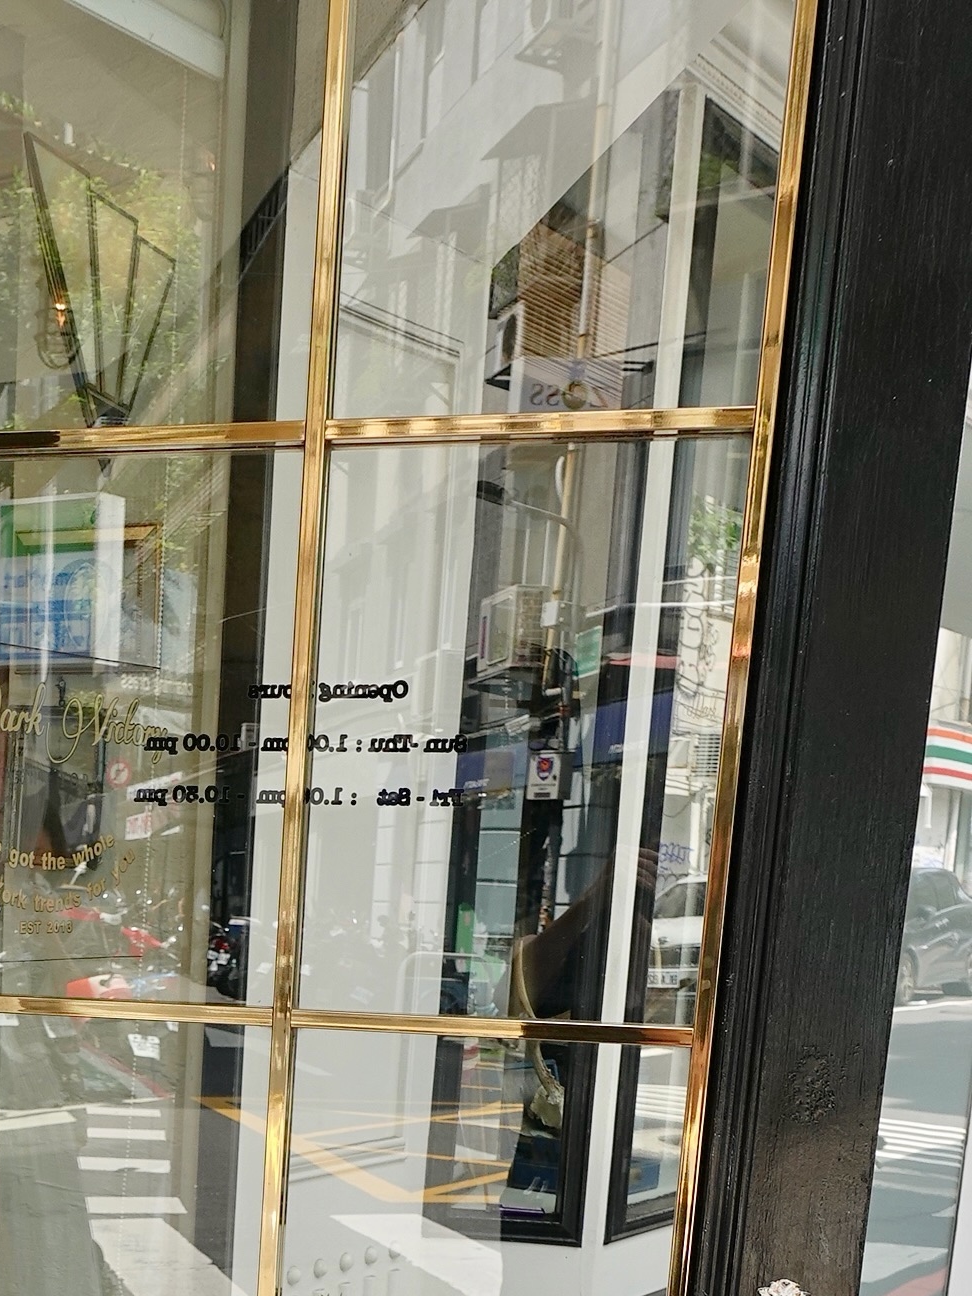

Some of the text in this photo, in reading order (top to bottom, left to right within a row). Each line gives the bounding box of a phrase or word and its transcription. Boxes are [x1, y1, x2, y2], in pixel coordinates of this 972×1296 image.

[9, 846, 36, 868] got
[42, 851, 66, 871] the
[72, 833, 115, 865] whole
[34, 892, 81, 913] trends
[86, 877, 106, 900] for
[111, 849, 135, 886] you
[19, 921, 41, 934] EST
